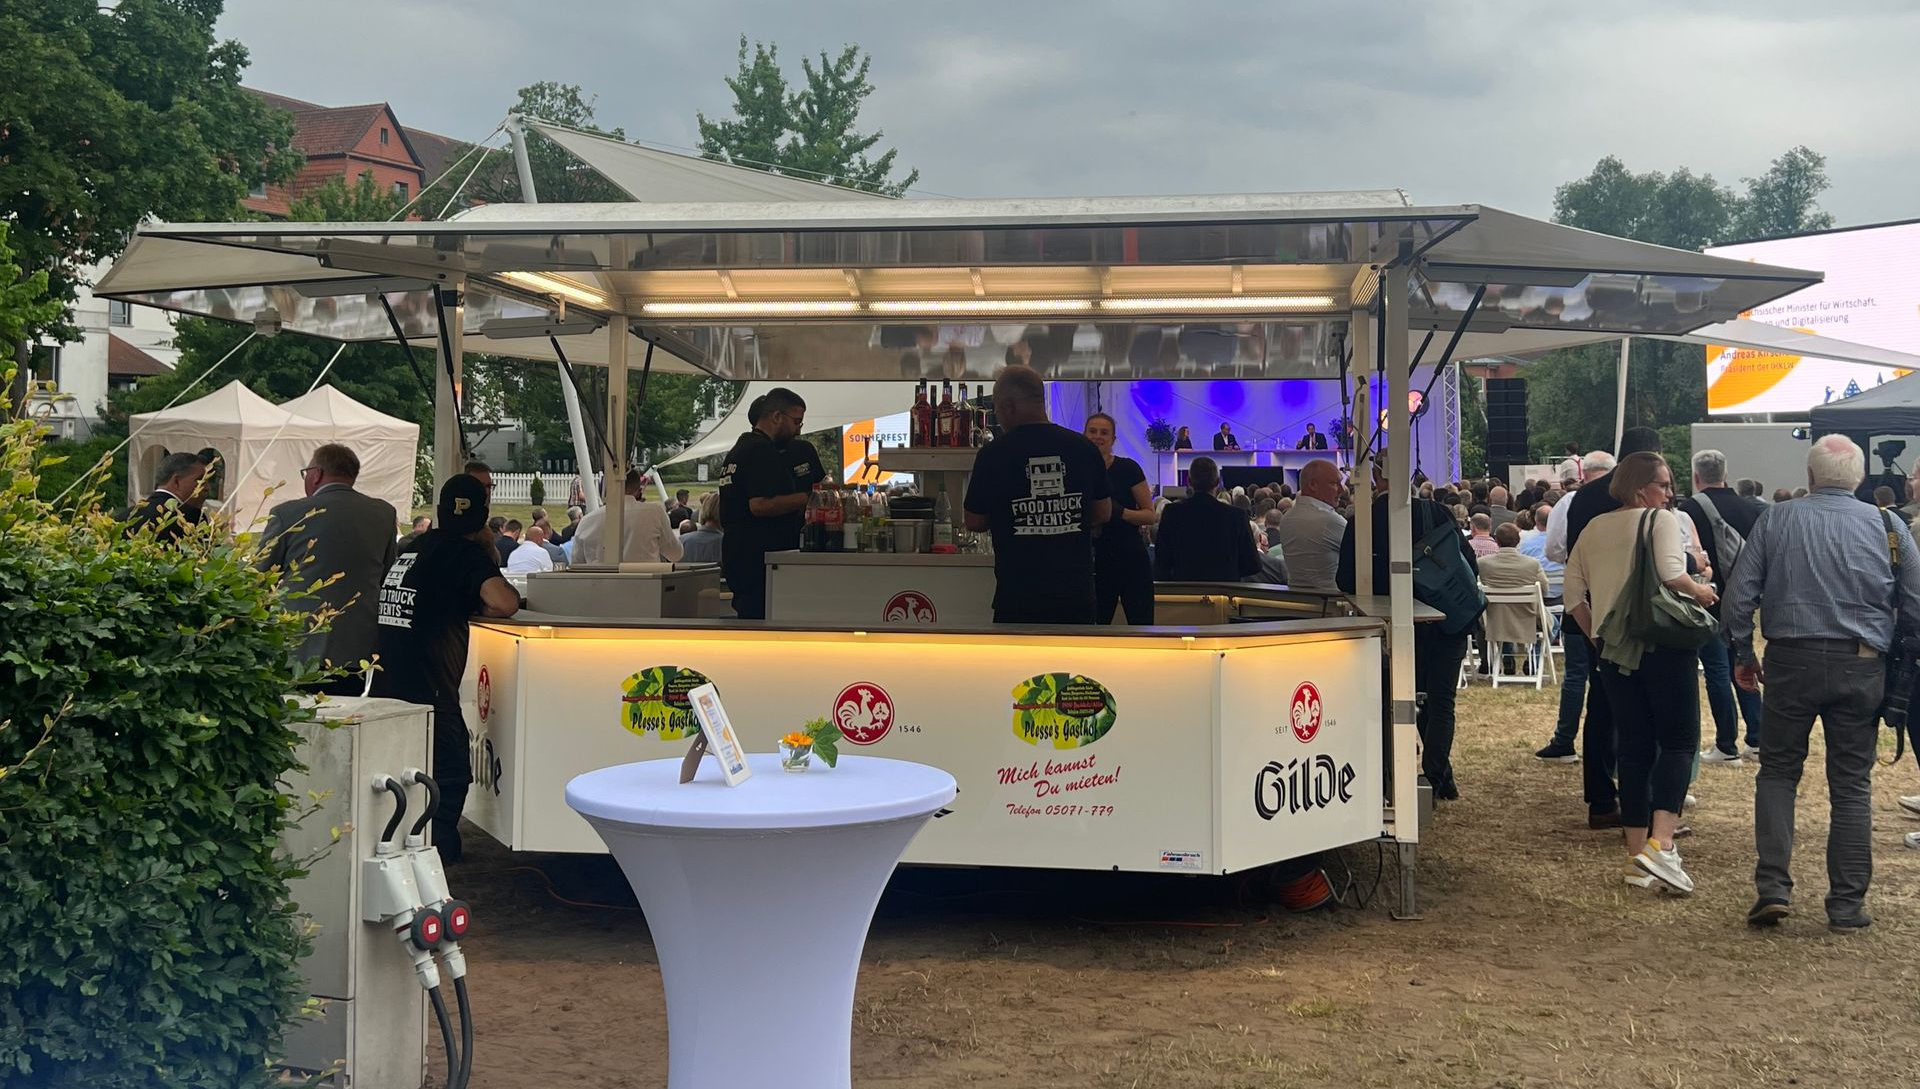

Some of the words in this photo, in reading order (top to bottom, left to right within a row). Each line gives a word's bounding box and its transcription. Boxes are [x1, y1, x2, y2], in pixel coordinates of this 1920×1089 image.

[1787, 303, 1817, 313] Minister
[1819, 300, 1831, 310] für
[1792, 314, 1849, 327] Digitalisierung
[1720, 350, 1755, 360] Andreas
[1756, 363, 1769, 372] der
[454, 497, 471, 515] P
[1011, 500, 1045, 516] FOOD
[1046, 496, 1082, 513] TRUCK
[1026, 511, 1072, 526] EVENTS
[387, 589, 417, 606] TRUCK
[378, 602, 402, 617] VENTS
[668, 709, 700, 732] Gastho
[1324, 719, 1337, 727] 1546
[899, 725, 922, 733] 1546
[1063, 718, 1098, 742] Gasthof
[1274, 725, 1288, 734] SEIT
[997, 761, 1039, 785] Mich
[1044, 753, 1096, 776] kannst
[1033, 779, 1060, 798] Du
[1065, 765, 1121, 792] mieten!
[1254, 754, 1356, 821] Gilde
[1006, 803, 1041, 818] Telefon
[1045, 804, 1114, 817] 05071-779
